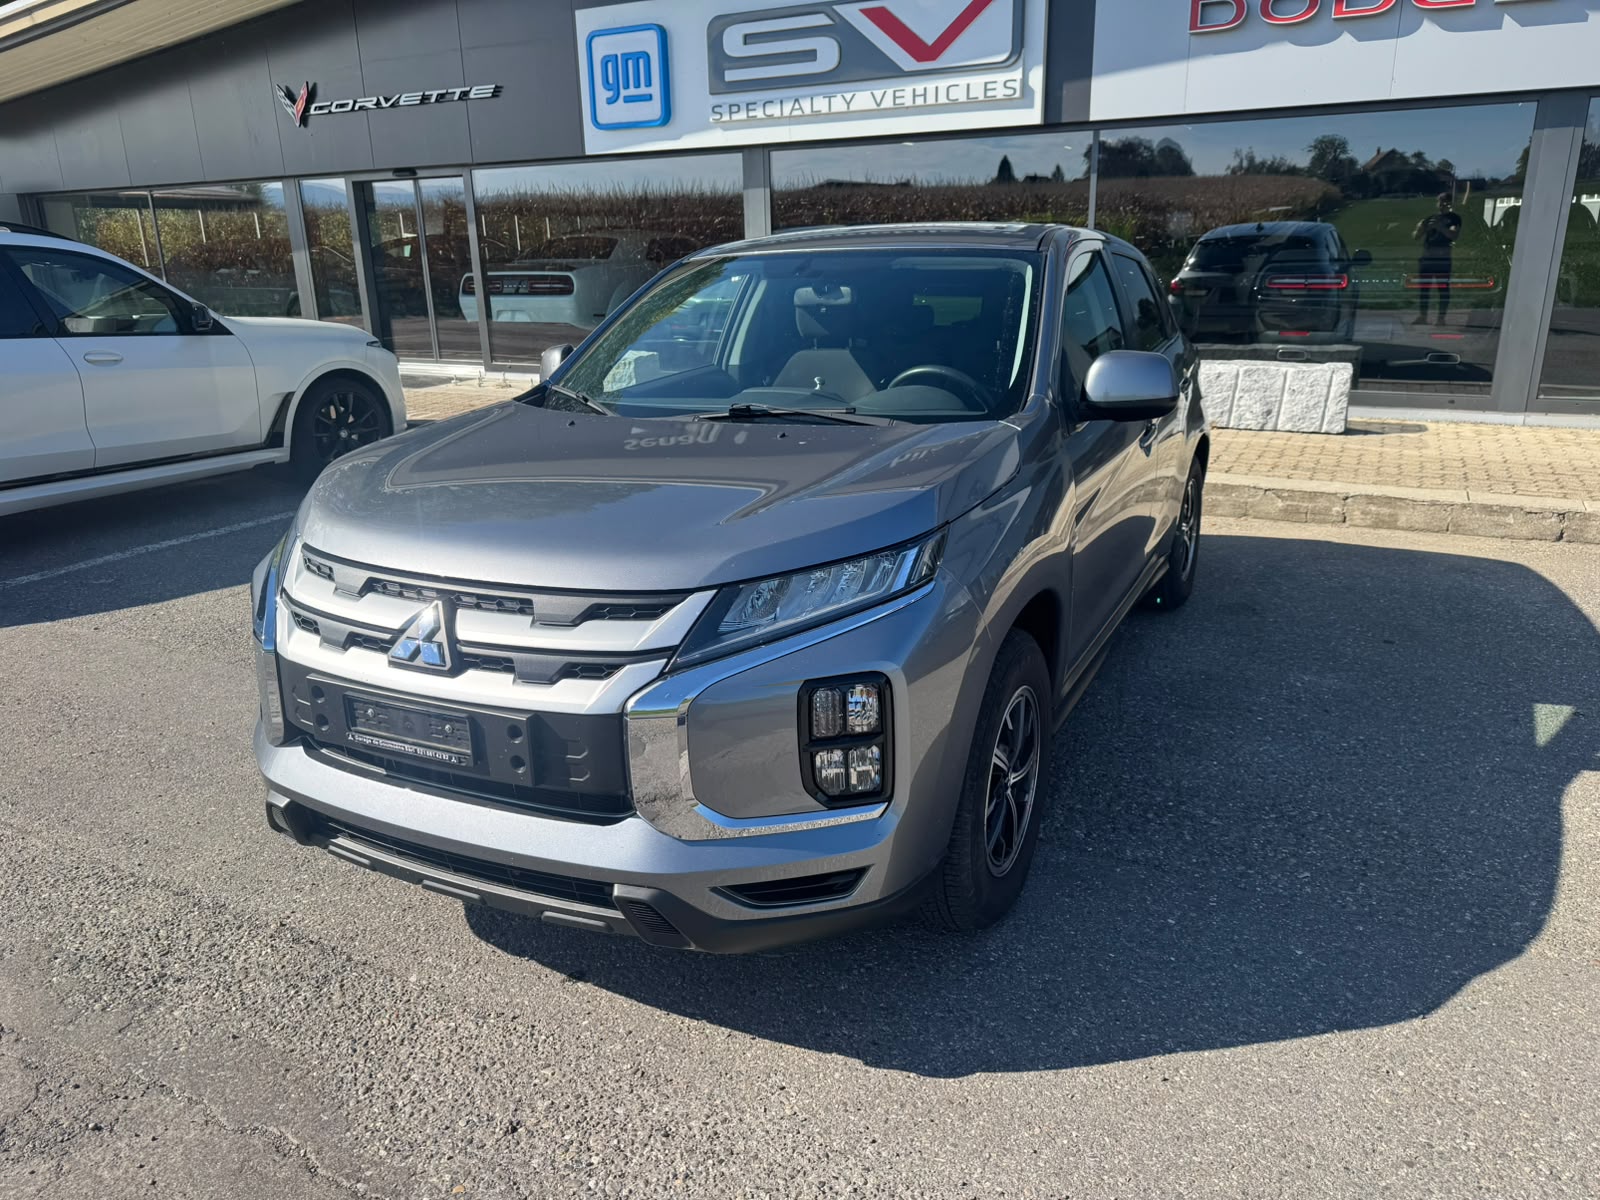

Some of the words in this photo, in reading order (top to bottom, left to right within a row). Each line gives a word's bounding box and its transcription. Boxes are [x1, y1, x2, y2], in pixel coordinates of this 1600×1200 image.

[601, 50, 652, 105] gm
[309, 84, 497, 116] CORVETTE
[711, 93, 857, 121] SPECIALTY
[870, 79, 1019, 107] VEHICLES
